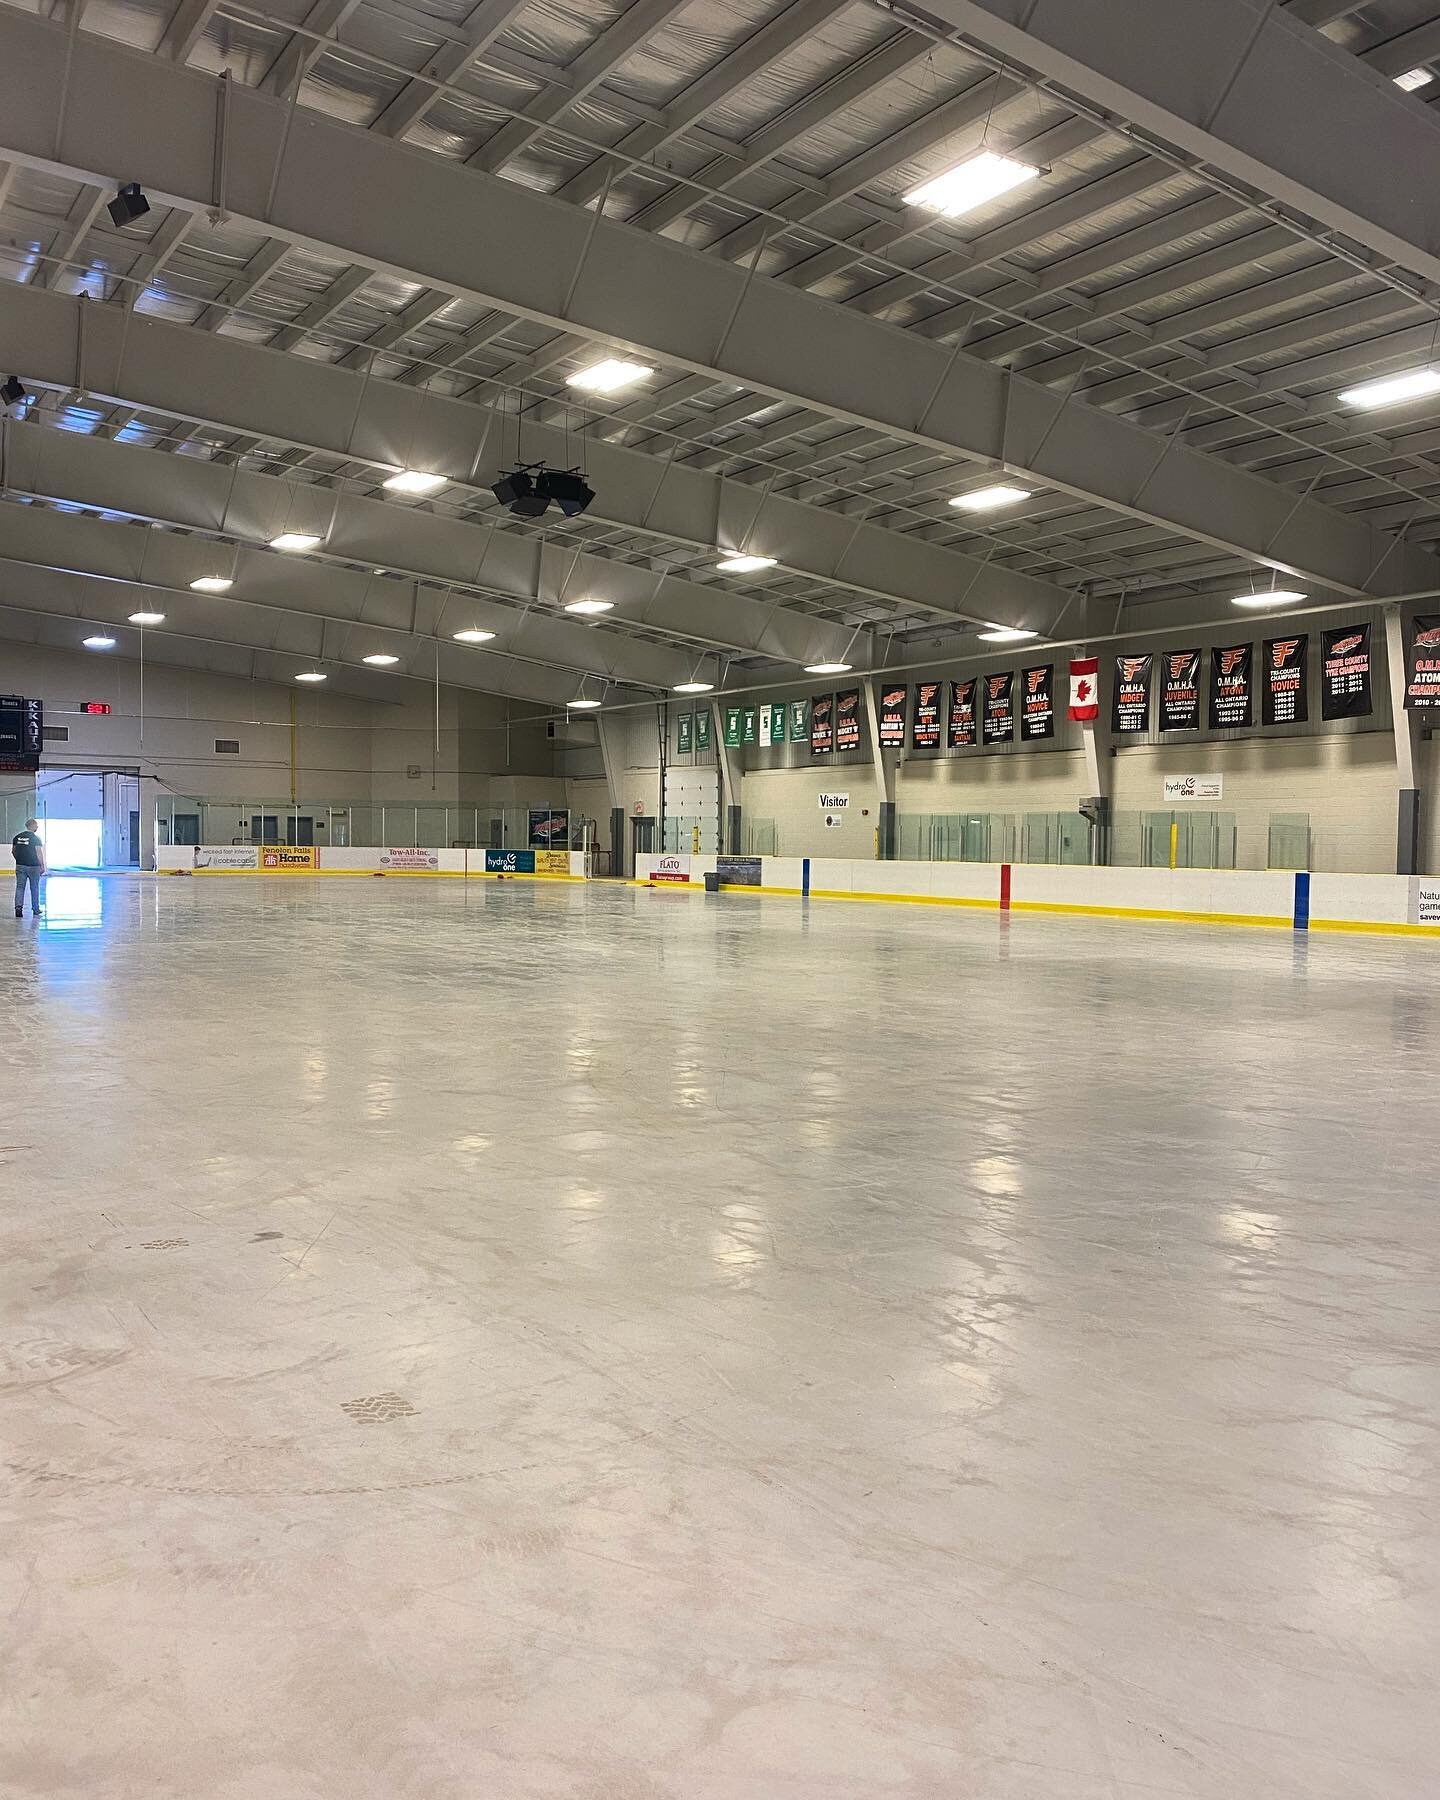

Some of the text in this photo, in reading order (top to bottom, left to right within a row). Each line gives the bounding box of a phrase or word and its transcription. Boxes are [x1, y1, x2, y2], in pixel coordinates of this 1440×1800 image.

[1217, 675, 1247, 686] O.M.H.A.
[1120, 684, 1146, 693] O.M.H.A.
[1167, 681, 1195, 691] O.M.H.A.
[1220, 686, 1244, 696] ATOM
[1271, 680, 1300, 692] NOVICE
[1120, 693, 1145, 703] MIDGET
[1164, 690, 1198, 701] JUVENILE
[1027, 702, 1049, 712] NOVICE
[1216, 701, 1247, 709] CHAMPIONS
[1165, 782, 1187, 793] hydro
[820, 794, 848, 807] Visitor
[279, 854, 311, 862] Home
[488, 856, 508, 867] hydro
[659, 860, 680, 869] FLATO
